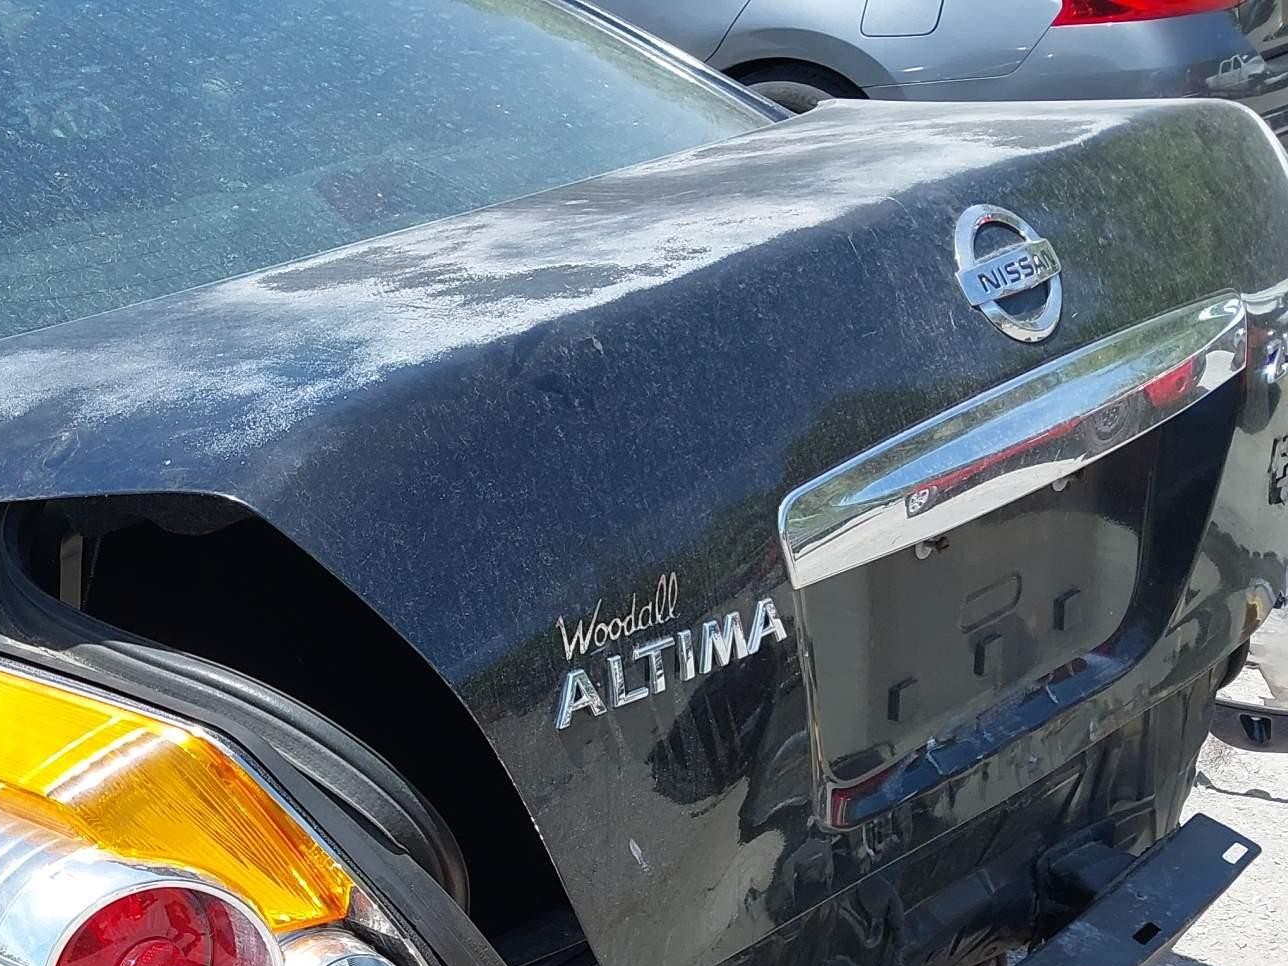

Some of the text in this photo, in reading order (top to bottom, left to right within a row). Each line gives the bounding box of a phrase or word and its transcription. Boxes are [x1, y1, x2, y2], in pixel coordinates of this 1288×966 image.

[977, 250, 1058, 293] NISSAN
[555, 571, 680, 662] Woodall
[553, 598, 788, 730] ALTIMA
